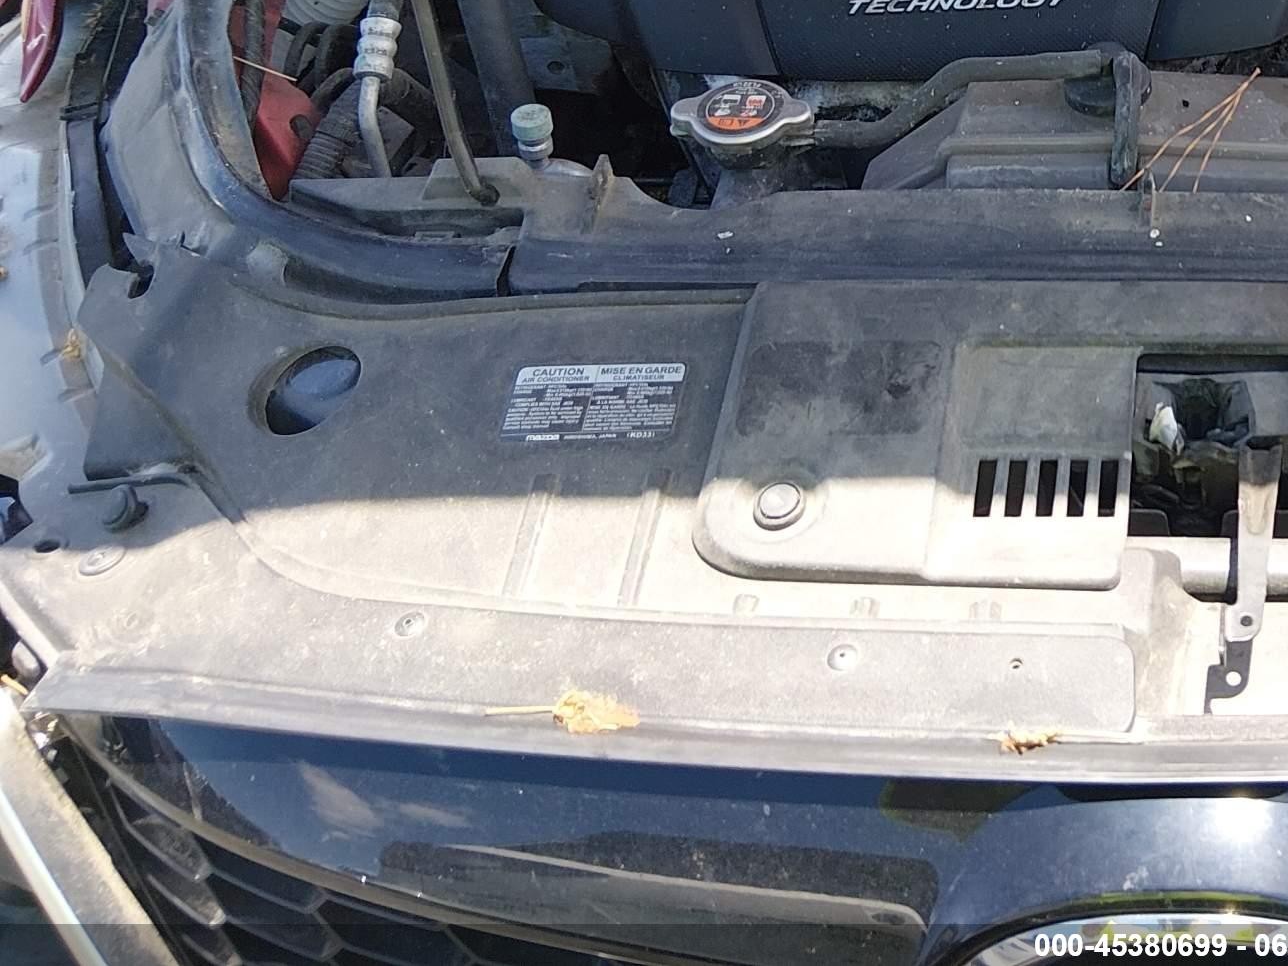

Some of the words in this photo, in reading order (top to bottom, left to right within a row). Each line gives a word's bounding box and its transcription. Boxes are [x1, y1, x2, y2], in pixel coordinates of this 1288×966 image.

[532, 367, 584, 377] CAUTION
[601, 367, 626, 375] MISE
[628, 366, 644, 374] EN
[645, 366, 683, 374] GARDE
